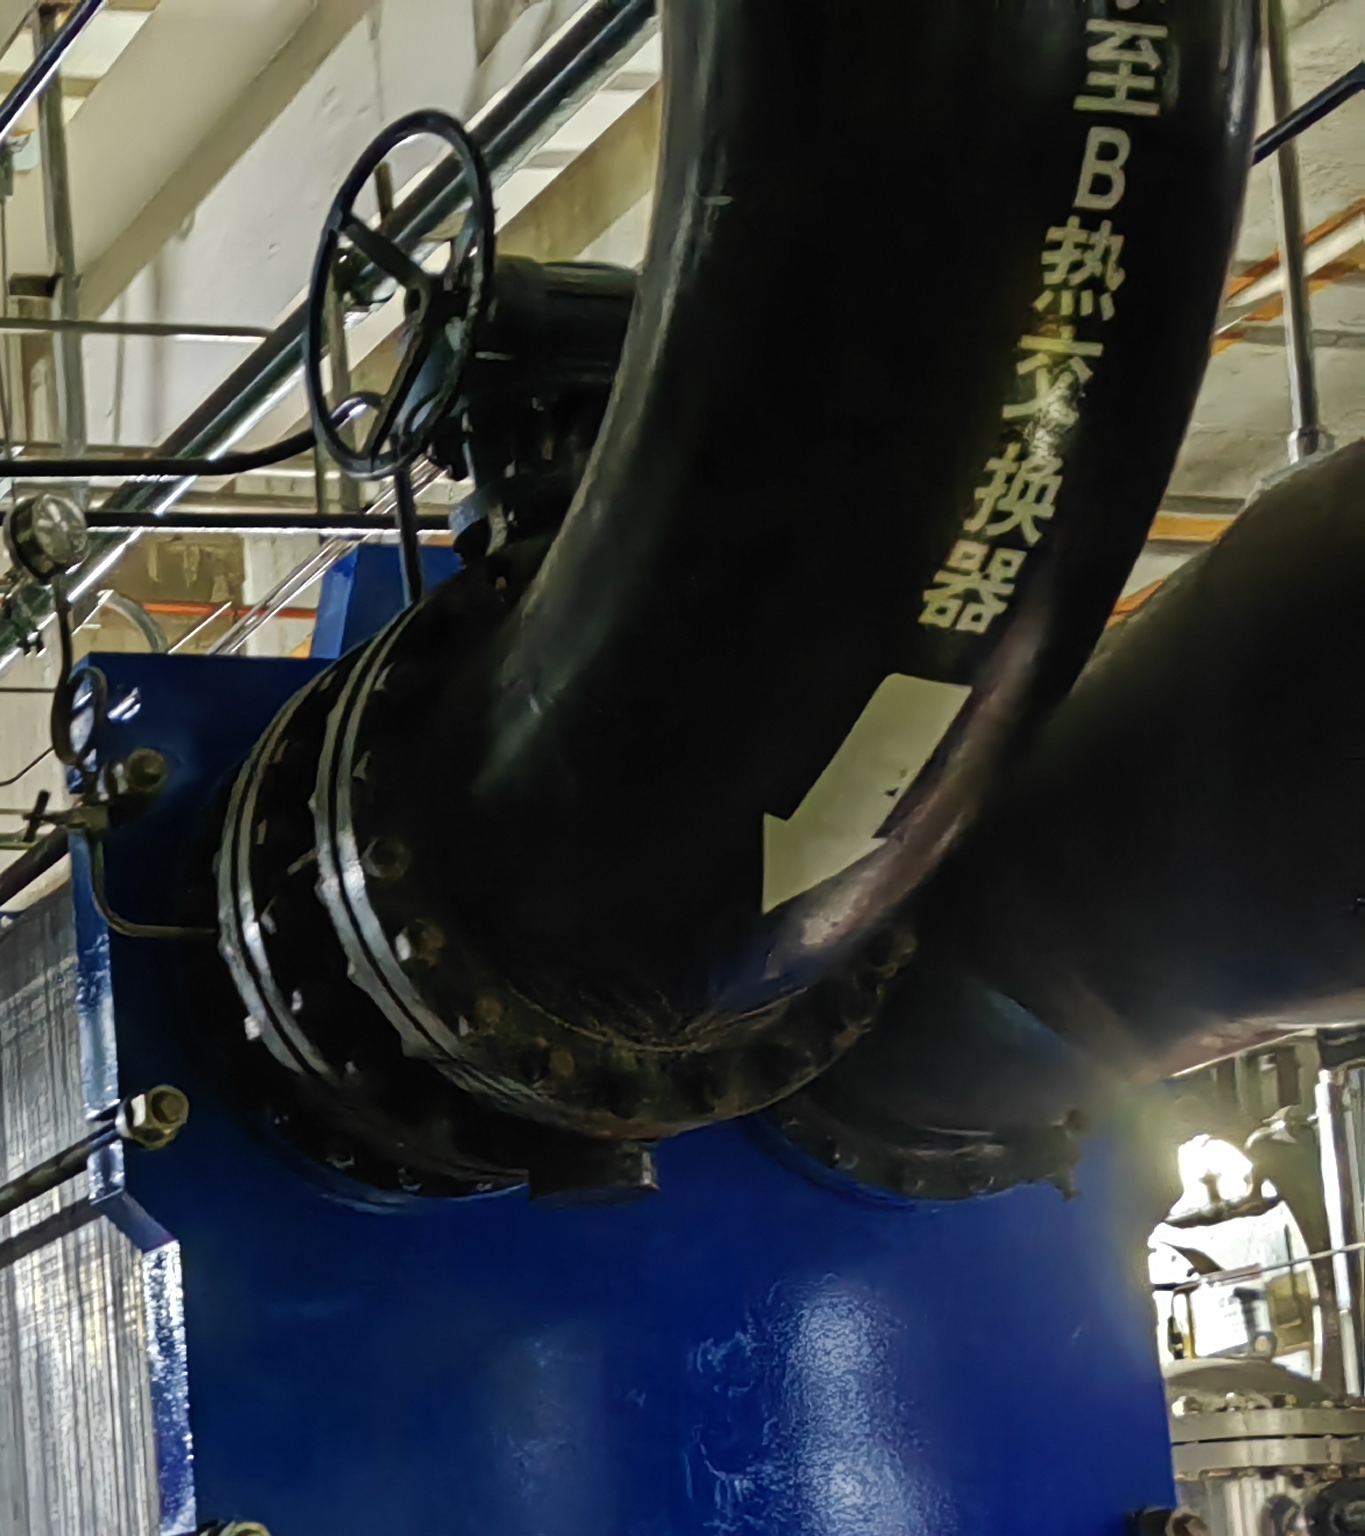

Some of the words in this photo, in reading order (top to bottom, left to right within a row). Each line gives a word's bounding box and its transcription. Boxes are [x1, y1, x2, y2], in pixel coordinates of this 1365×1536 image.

[918, 0, 1168, 634] 至B热交换器
